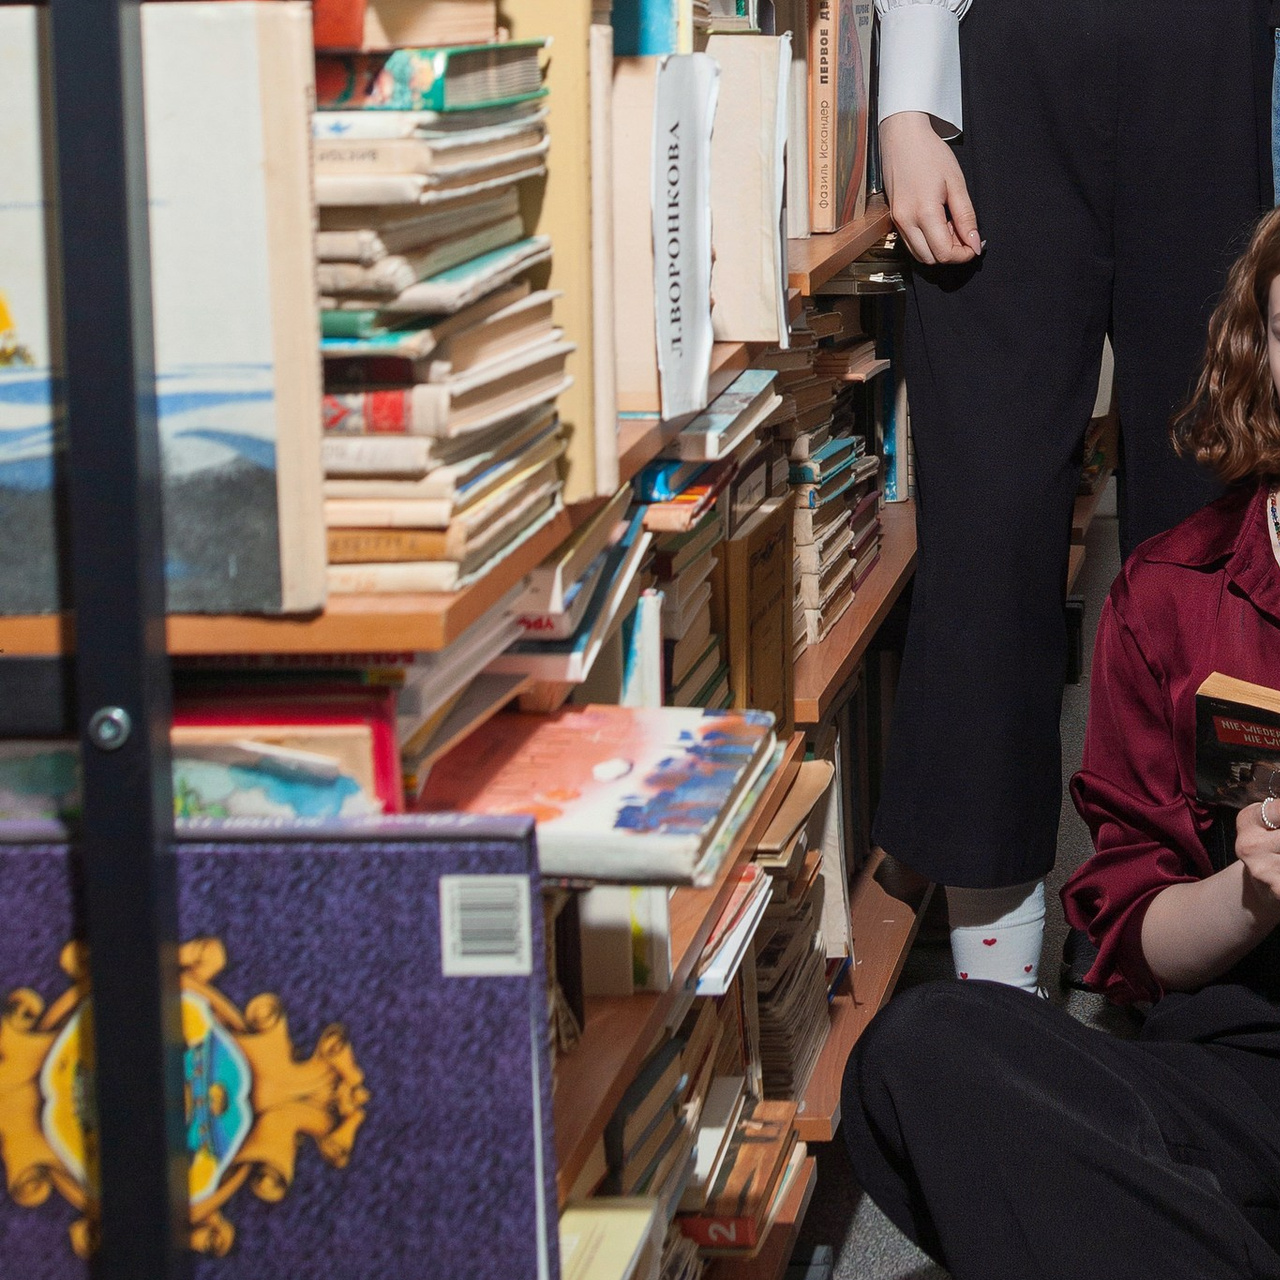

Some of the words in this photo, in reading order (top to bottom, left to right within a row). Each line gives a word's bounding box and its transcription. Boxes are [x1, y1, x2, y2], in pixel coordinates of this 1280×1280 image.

[819, 28, 830, 85] ПЕРВОЕ
[818, 99, 830, 159] Искандер
[818, 162, 830, 210] Фазиль
[663, 120, 684, 359] Л.ВОРОНКОВА
[1221, 719, 1241, 732] NIE
[1243, 733, 1262, 744] NIE
[709, 1220, 737, 1243] 2
